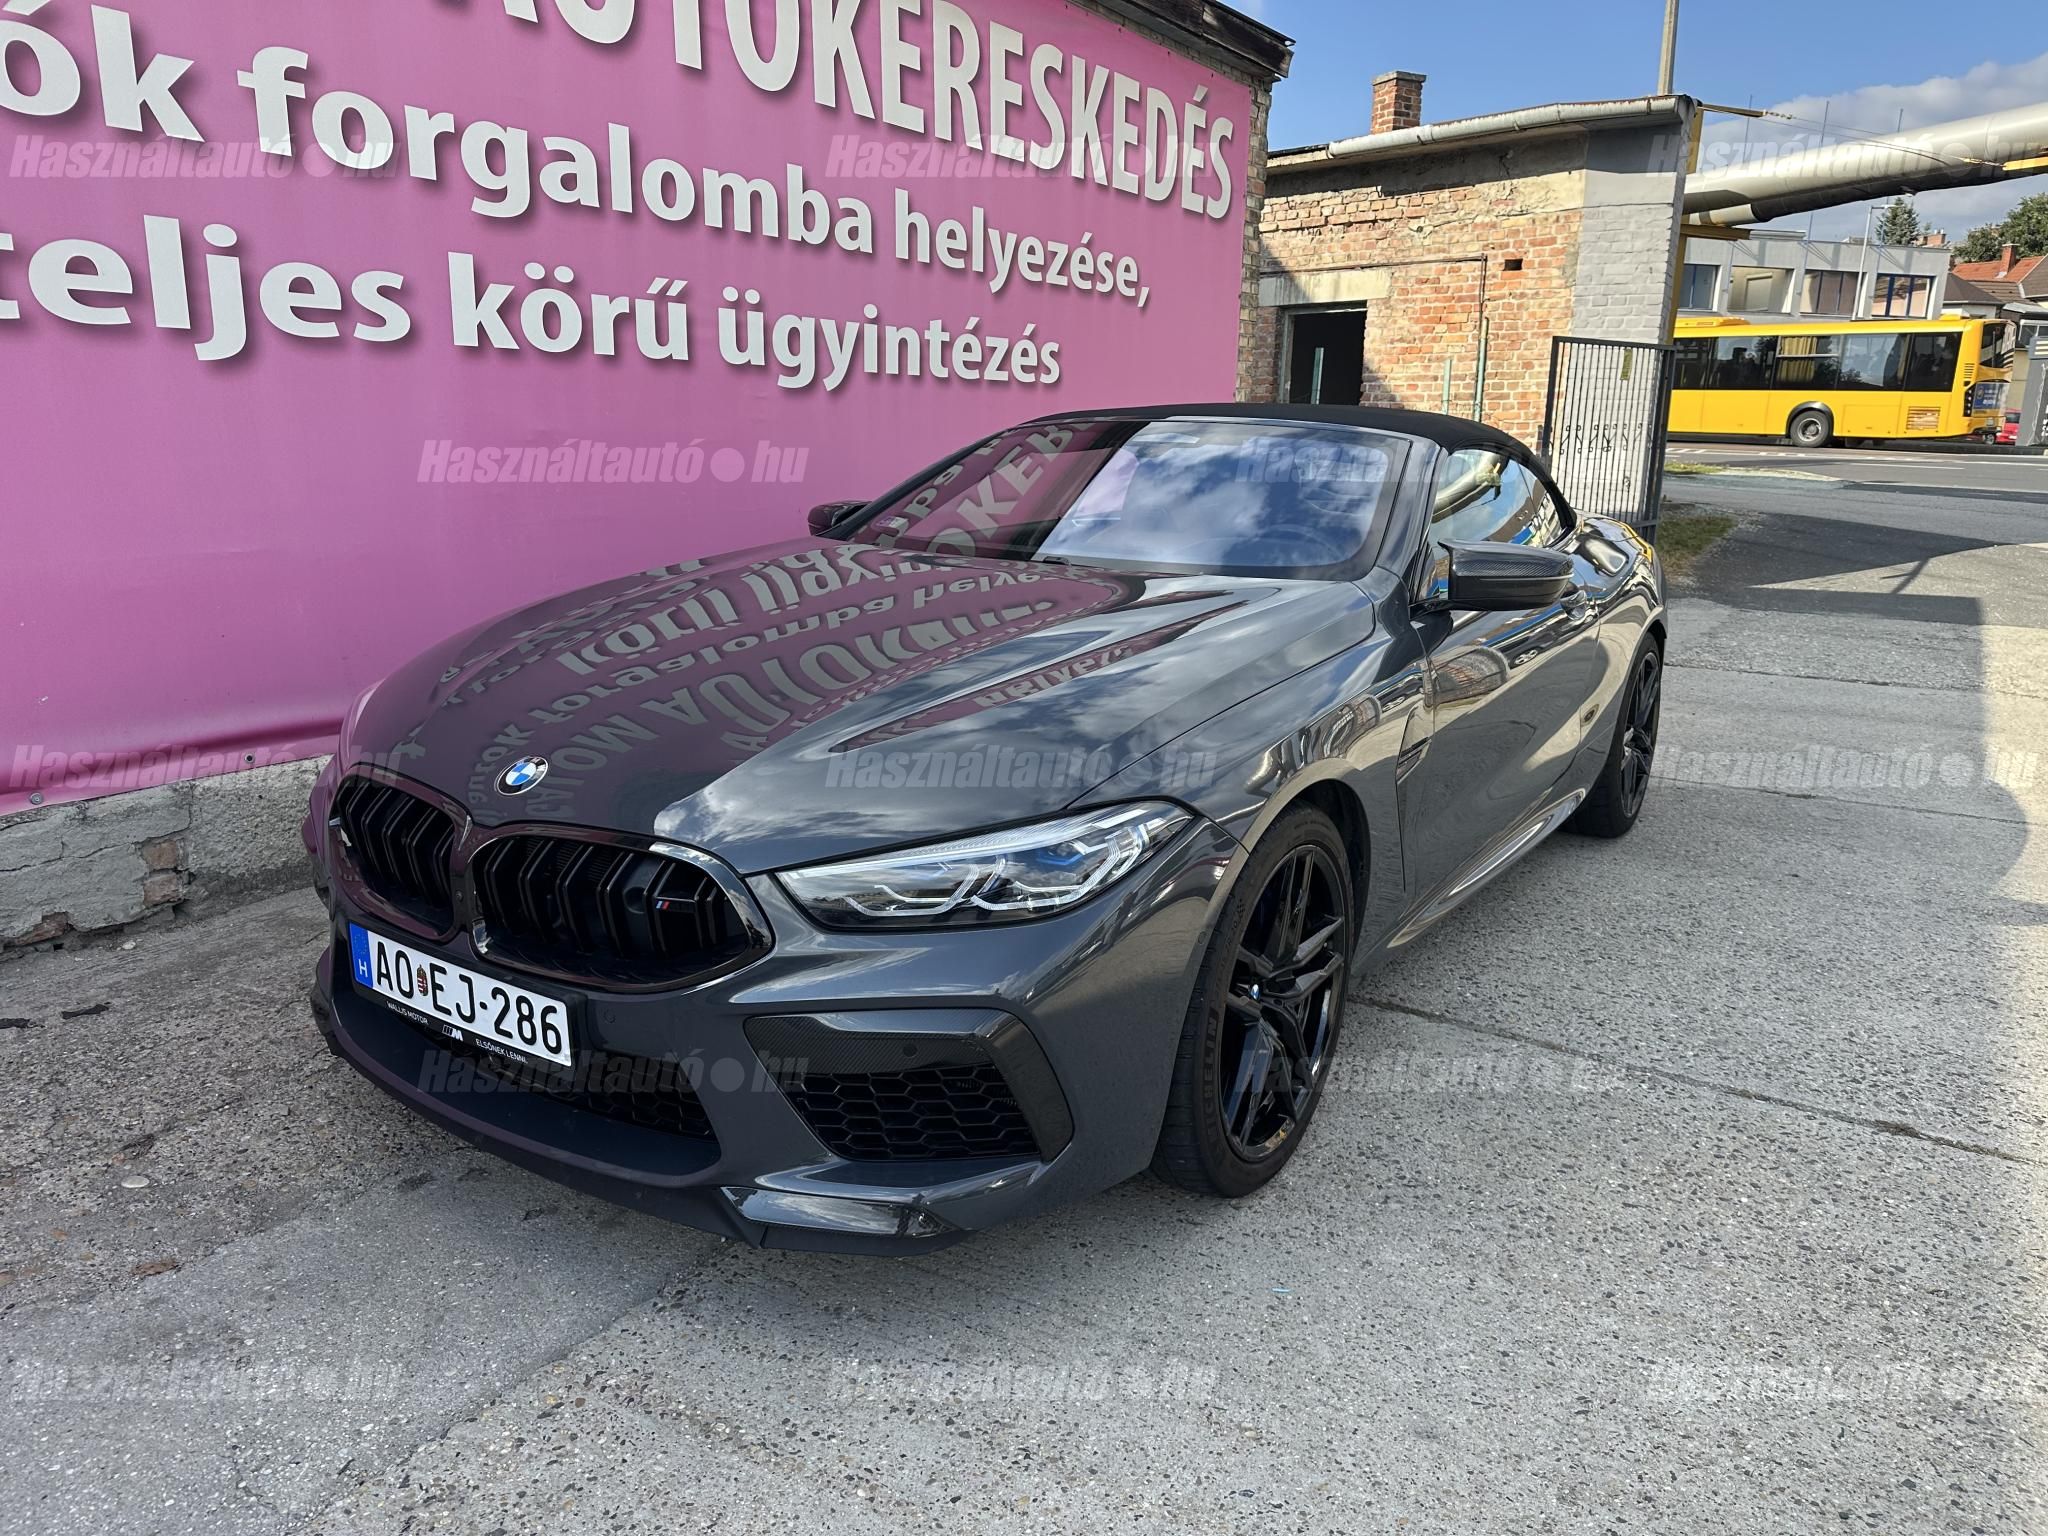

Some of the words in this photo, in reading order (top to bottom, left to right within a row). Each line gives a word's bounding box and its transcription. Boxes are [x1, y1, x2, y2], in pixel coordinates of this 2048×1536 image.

[237, 46, 873, 254] forgalomba
[895, 188, 1150, 308] helyezése,
[448, 251, 689, 361] körű
[717, 287, 1061, 391] ügyintézés
[359, 959, 368, 978] H
